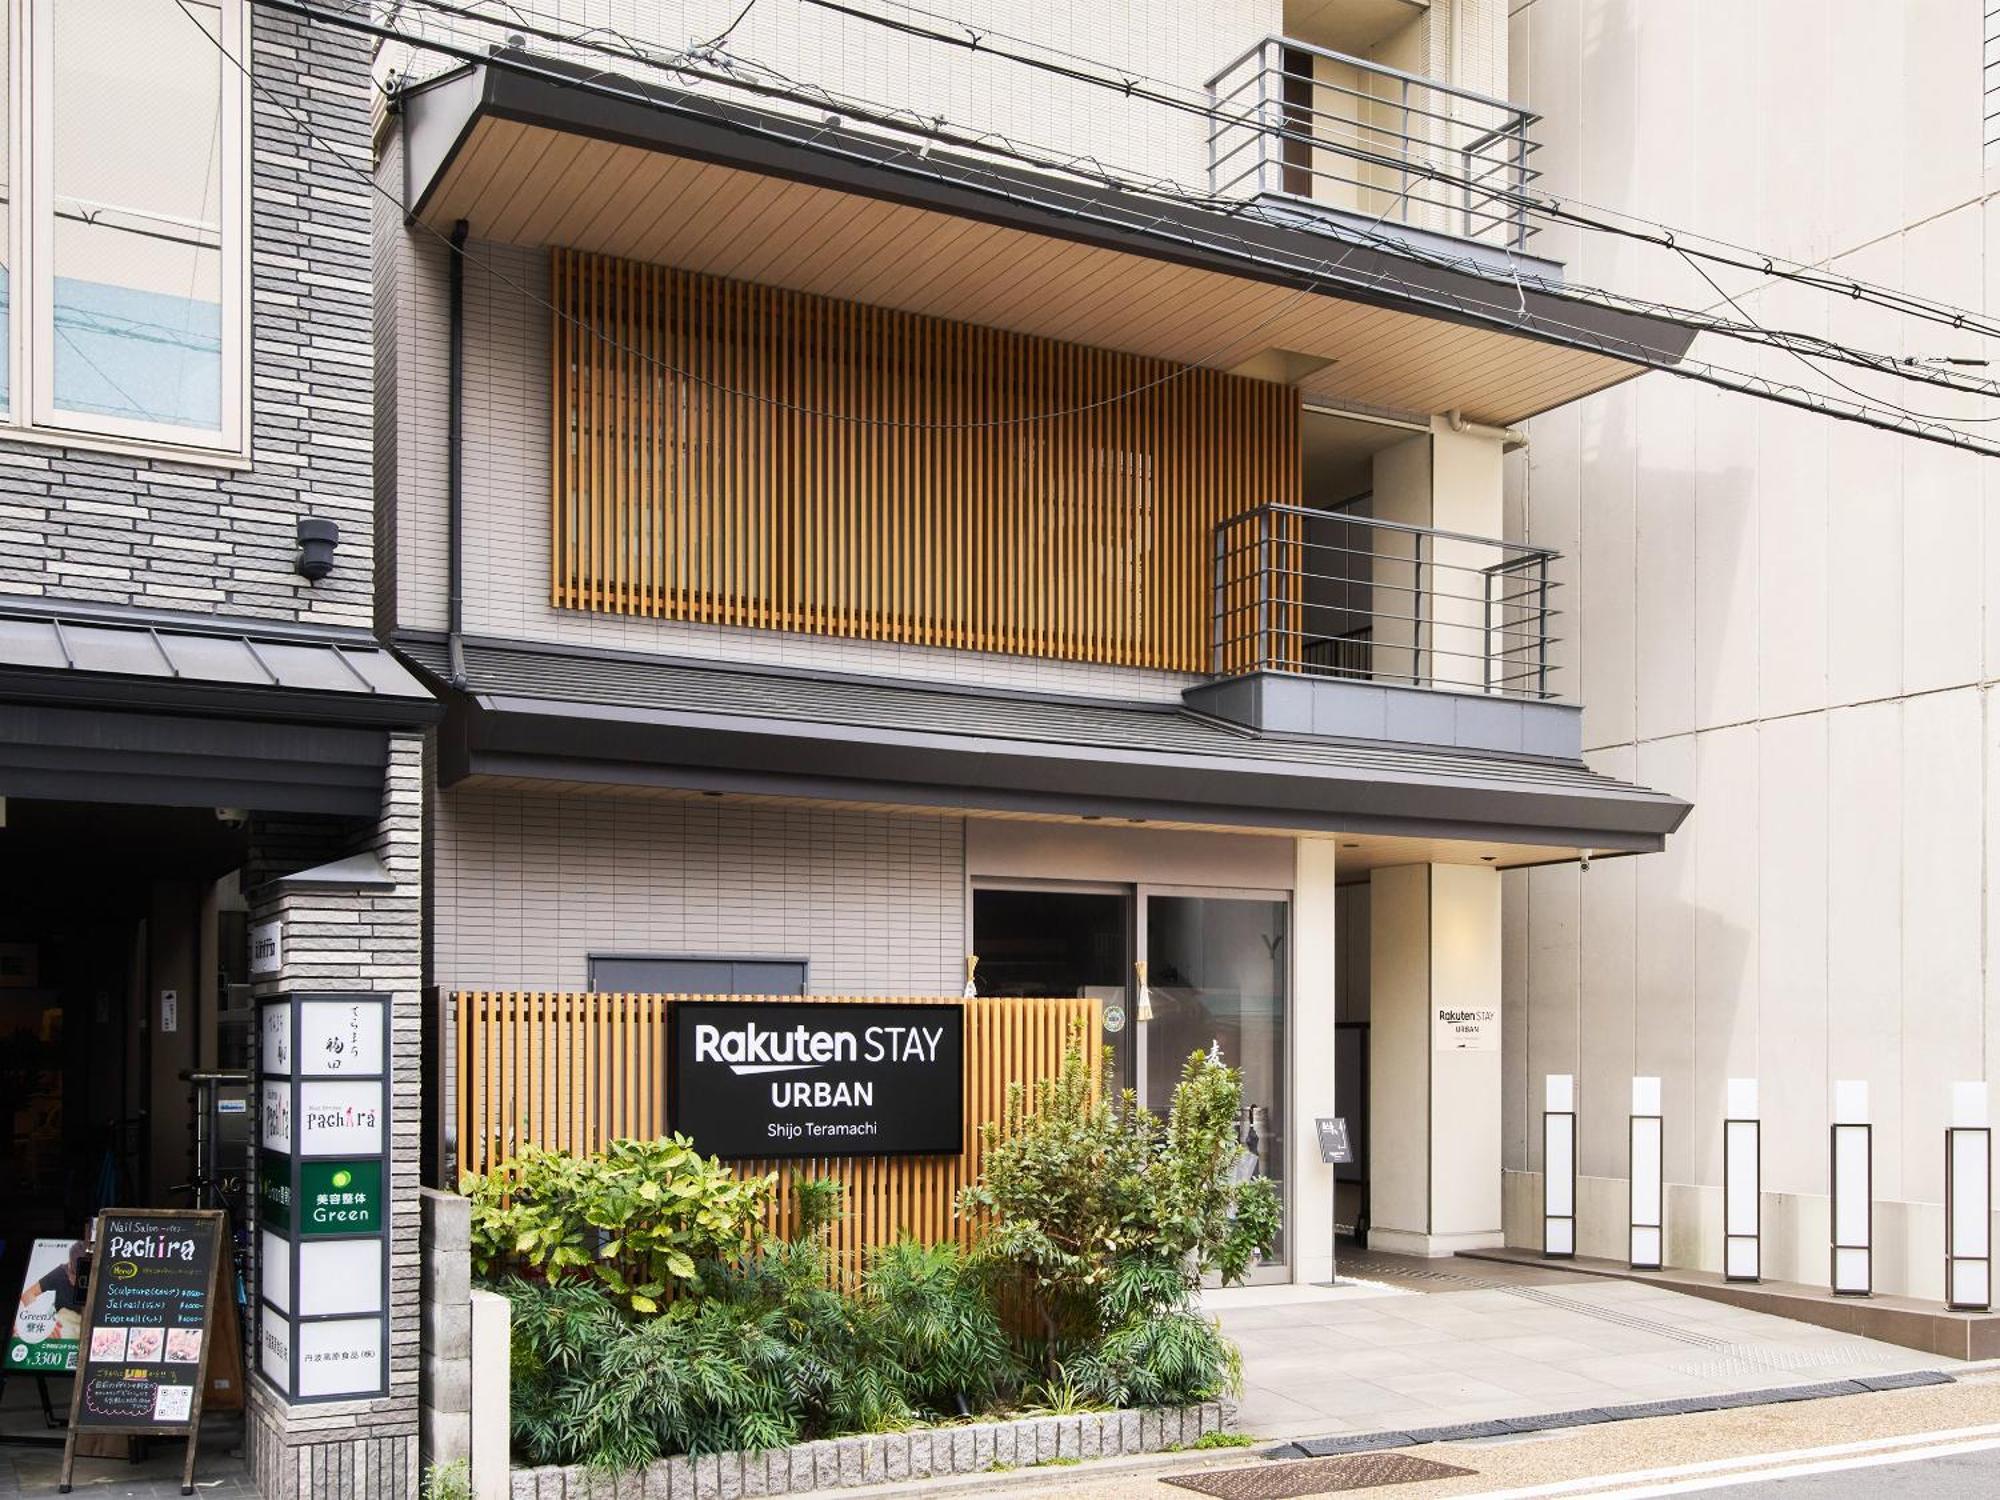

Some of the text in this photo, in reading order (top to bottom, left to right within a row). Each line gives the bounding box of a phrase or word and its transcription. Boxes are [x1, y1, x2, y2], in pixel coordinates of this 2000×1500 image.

[1439, 1010, 1496, 1021] Rakuten STAY
[695, 1022, 944, 1063] Rakuten STAY
[771, 1082, 873, 1108] URBAN
[767, 1121, 877, 1140] Shijo Teramachi
[316, 1192, 367, 1206] 美容整体
[313, 1207, 369, 1222] Green
[110, 1235, 196, 1261] Pachira
